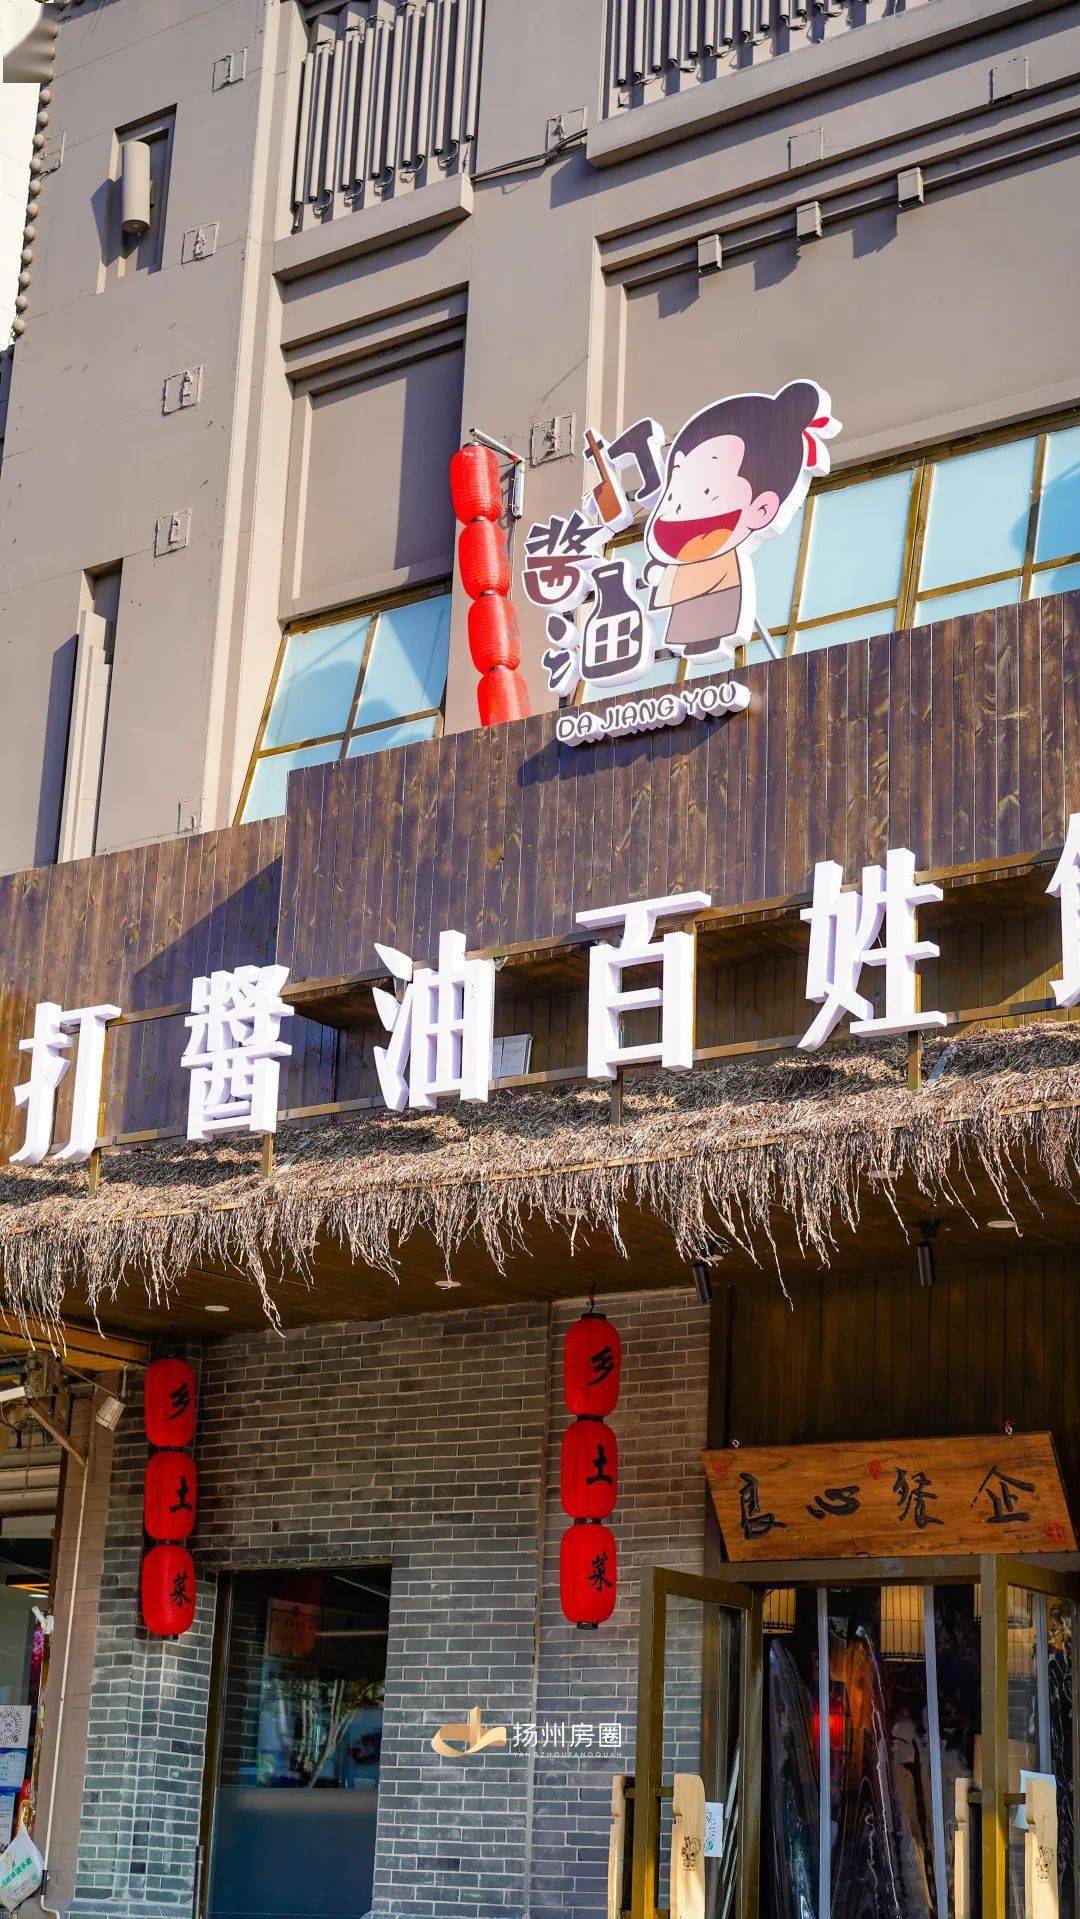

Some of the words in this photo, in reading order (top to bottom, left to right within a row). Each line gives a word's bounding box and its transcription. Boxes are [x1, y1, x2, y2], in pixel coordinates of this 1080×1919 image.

[523, 416, 665, 692] 打酱油
[557, 711, 594, 739] DA
[600, 696, 675, 730] JIANG
[680, 682, 737, 714] YOU
[164, 1382, 192, 1609] 乡土菜
[586, 1346, 615, 1593] 乡土菜
